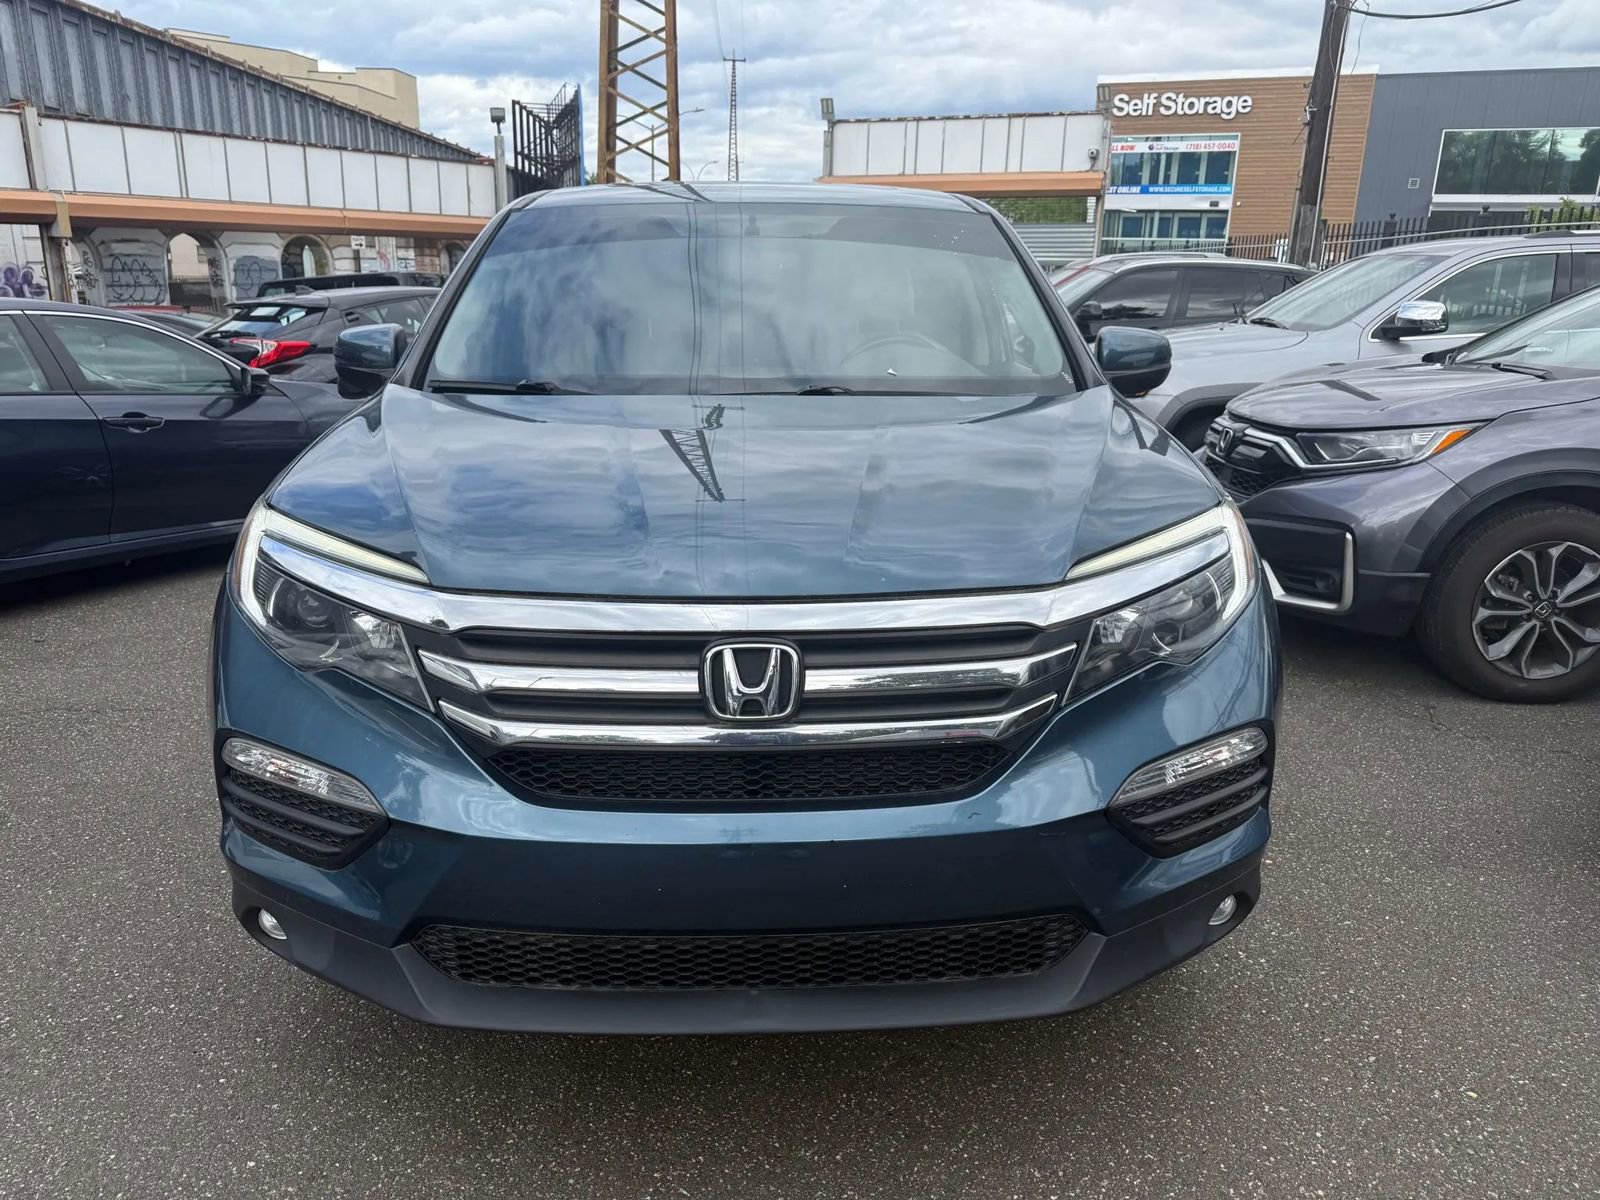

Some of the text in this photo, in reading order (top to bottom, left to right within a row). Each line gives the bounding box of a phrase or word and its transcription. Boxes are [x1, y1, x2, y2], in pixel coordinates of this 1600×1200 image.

[1113, 92, 1252, 119] Self Storage
[1203, 142, 1236, 150] 457-0040
